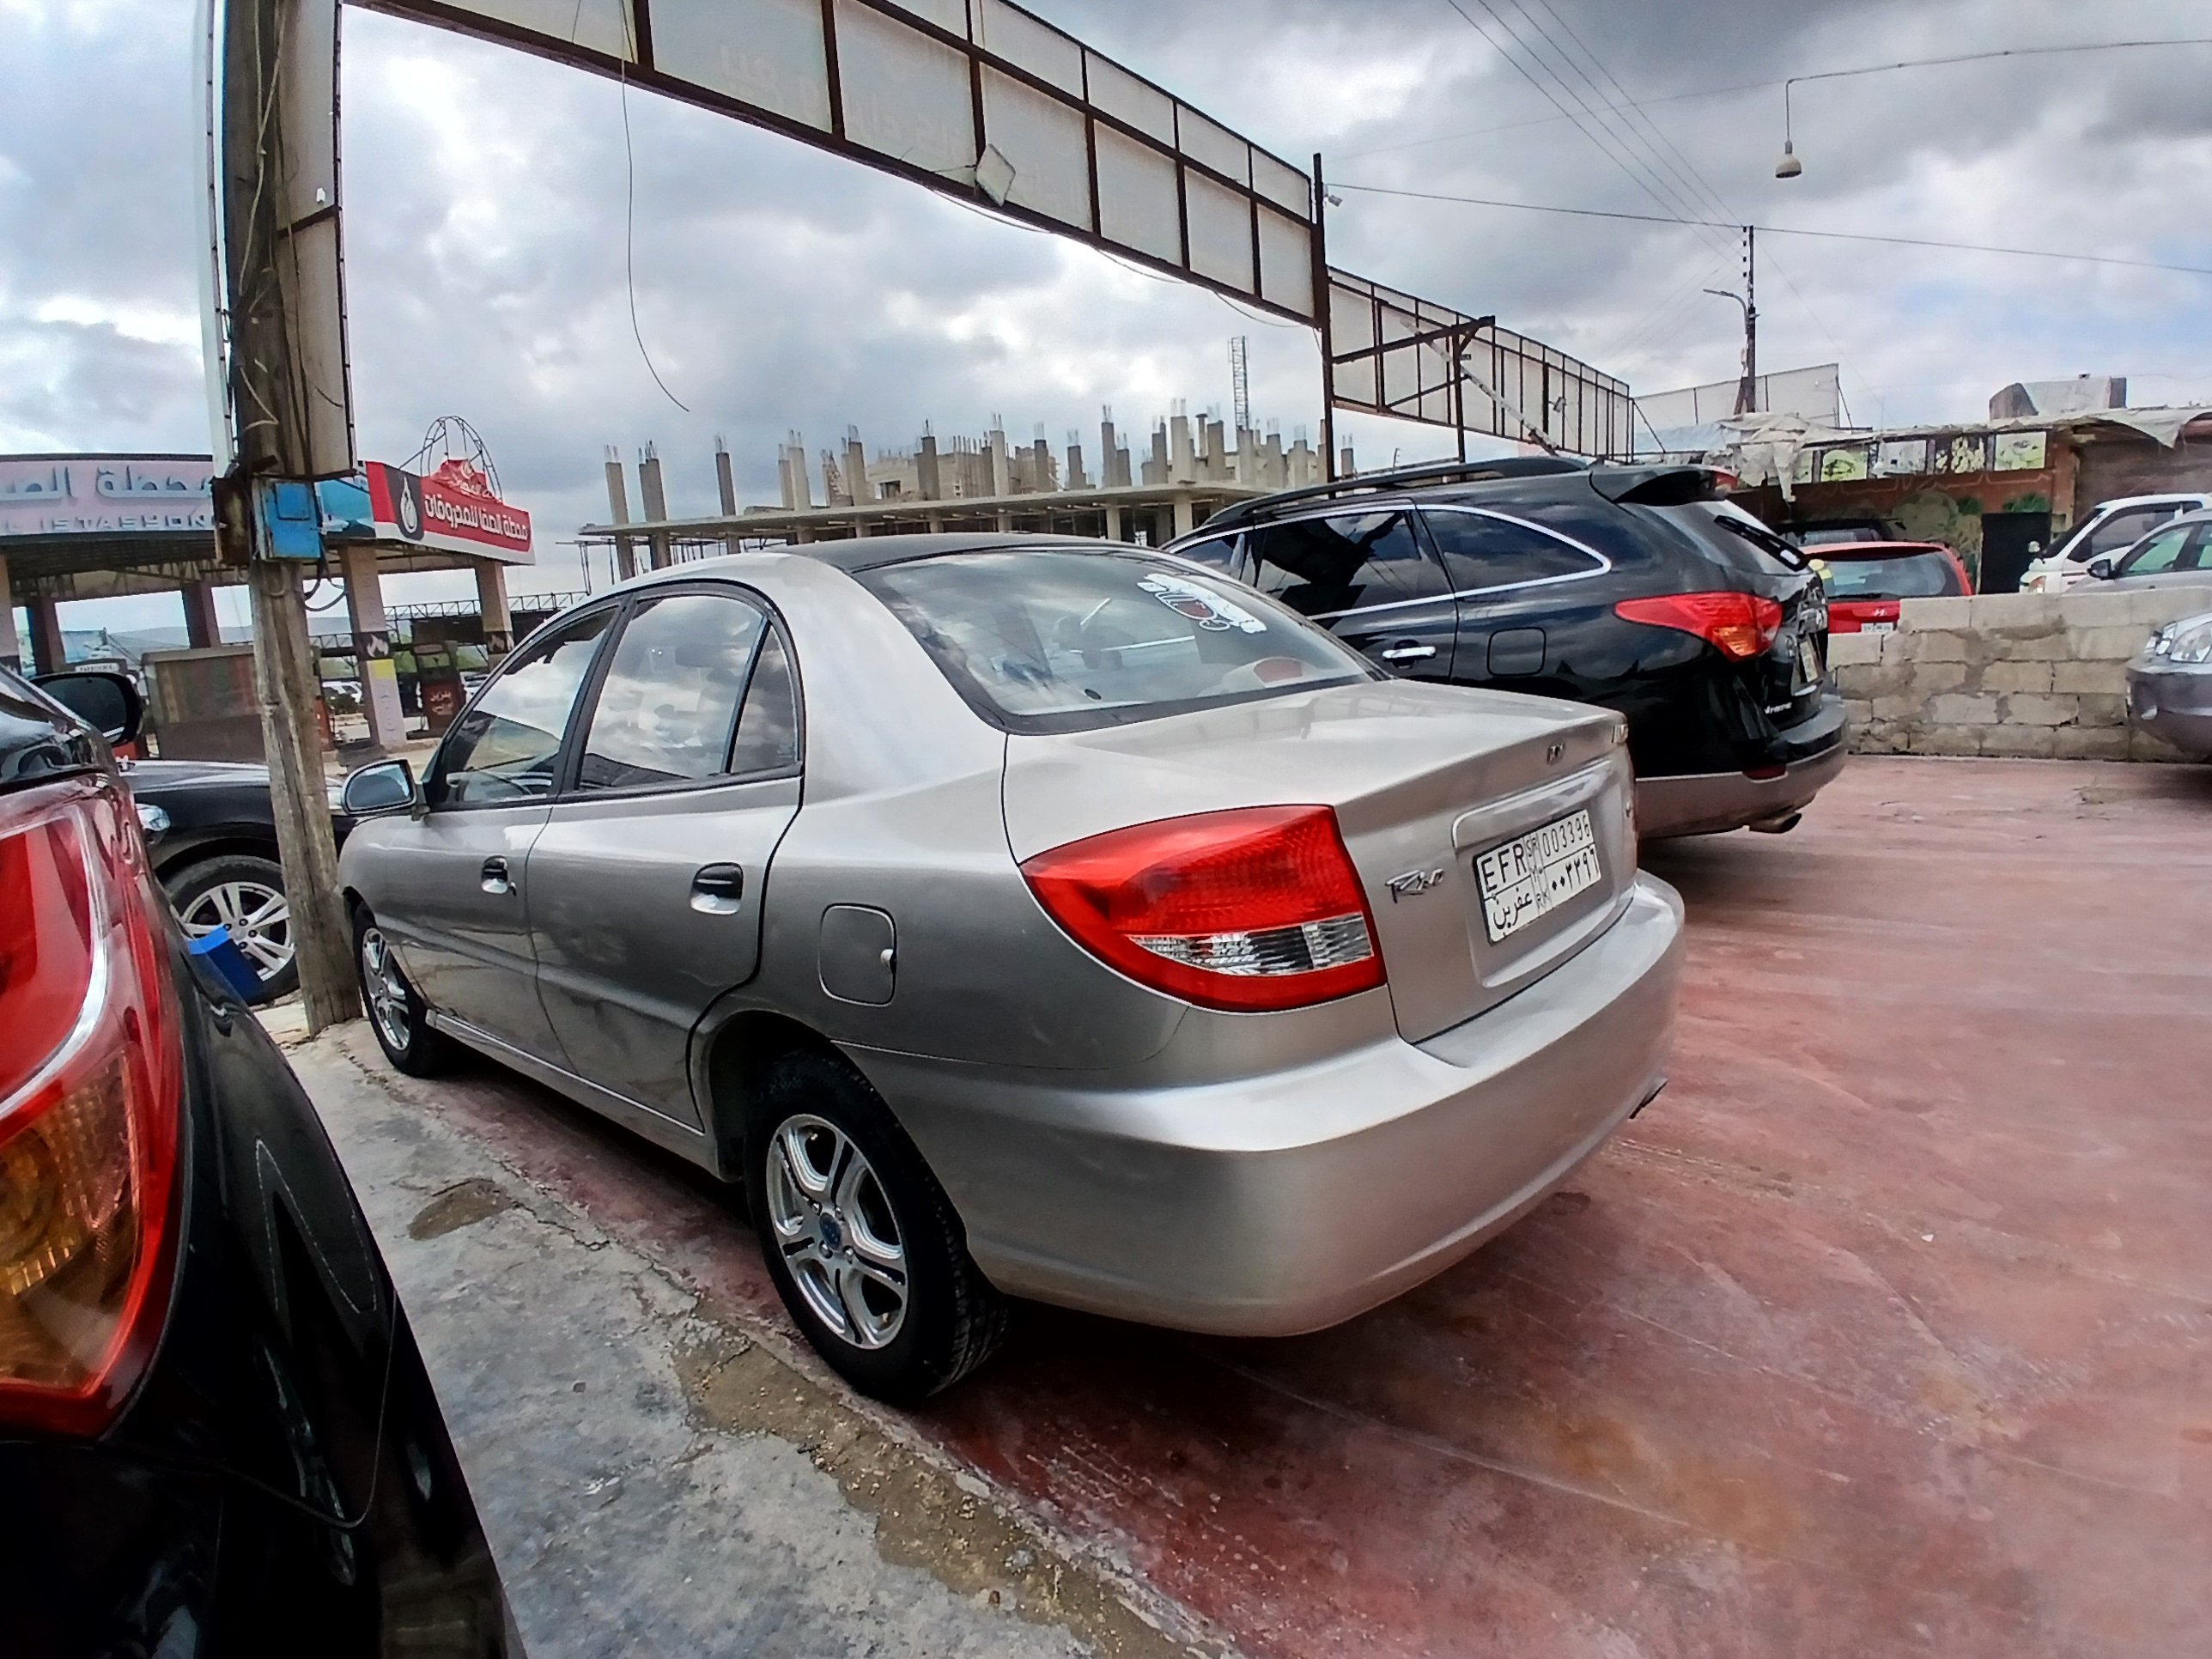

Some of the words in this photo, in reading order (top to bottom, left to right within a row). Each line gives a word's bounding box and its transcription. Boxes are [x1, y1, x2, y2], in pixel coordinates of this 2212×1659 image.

[424, 494, 478, 529] للمحروقات
[478, 507, 504, 536] الصفا
[502, 514, 529, 541] محطة
[1542, 814, 1590, 858] 003396
[1480, 842, 1528, 894] EFR
[1492, 886, 1534, 931] عفرين
